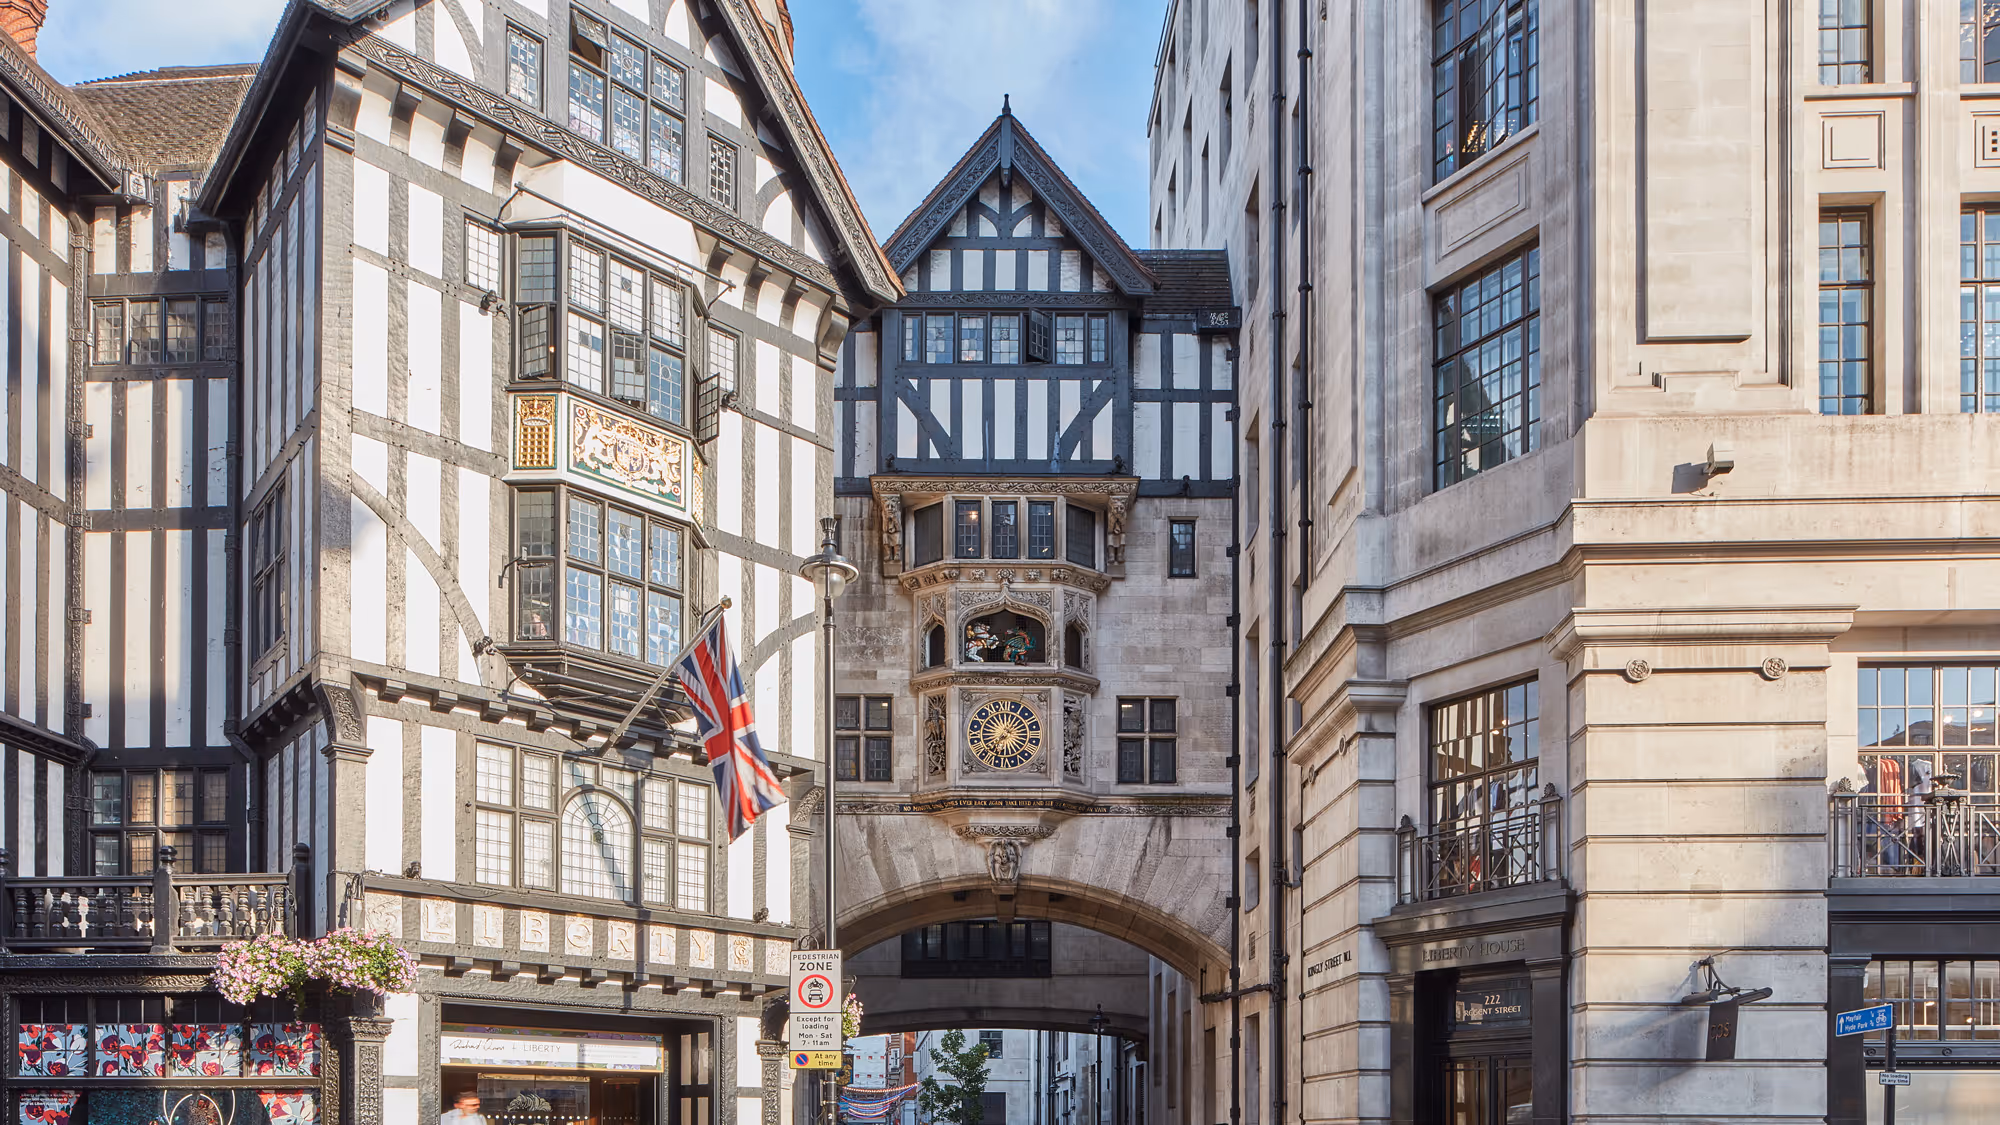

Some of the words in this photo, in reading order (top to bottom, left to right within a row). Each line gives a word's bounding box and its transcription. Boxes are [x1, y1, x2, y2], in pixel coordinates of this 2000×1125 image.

[424, 903, 711, 961] LIBERTY
[1422, 945, 1474, 962] LIBERTY
[1480, 938, 1525, 956] HOUSE
[799, 962, 833, 971] ZONE
[1308, 962, 1323, 977] KINGLY
[1485, 995, 1500, 1005] 222
[1495, 1006, 1521, 1014] STREET
[1845, 1013, 1862, 1023] Mayfair
[802, 1023, 829, 1031] loading
[1845, 1024, 1856, 1032] Hyde
[523, 1044, 561, 1053] LIBERTY
